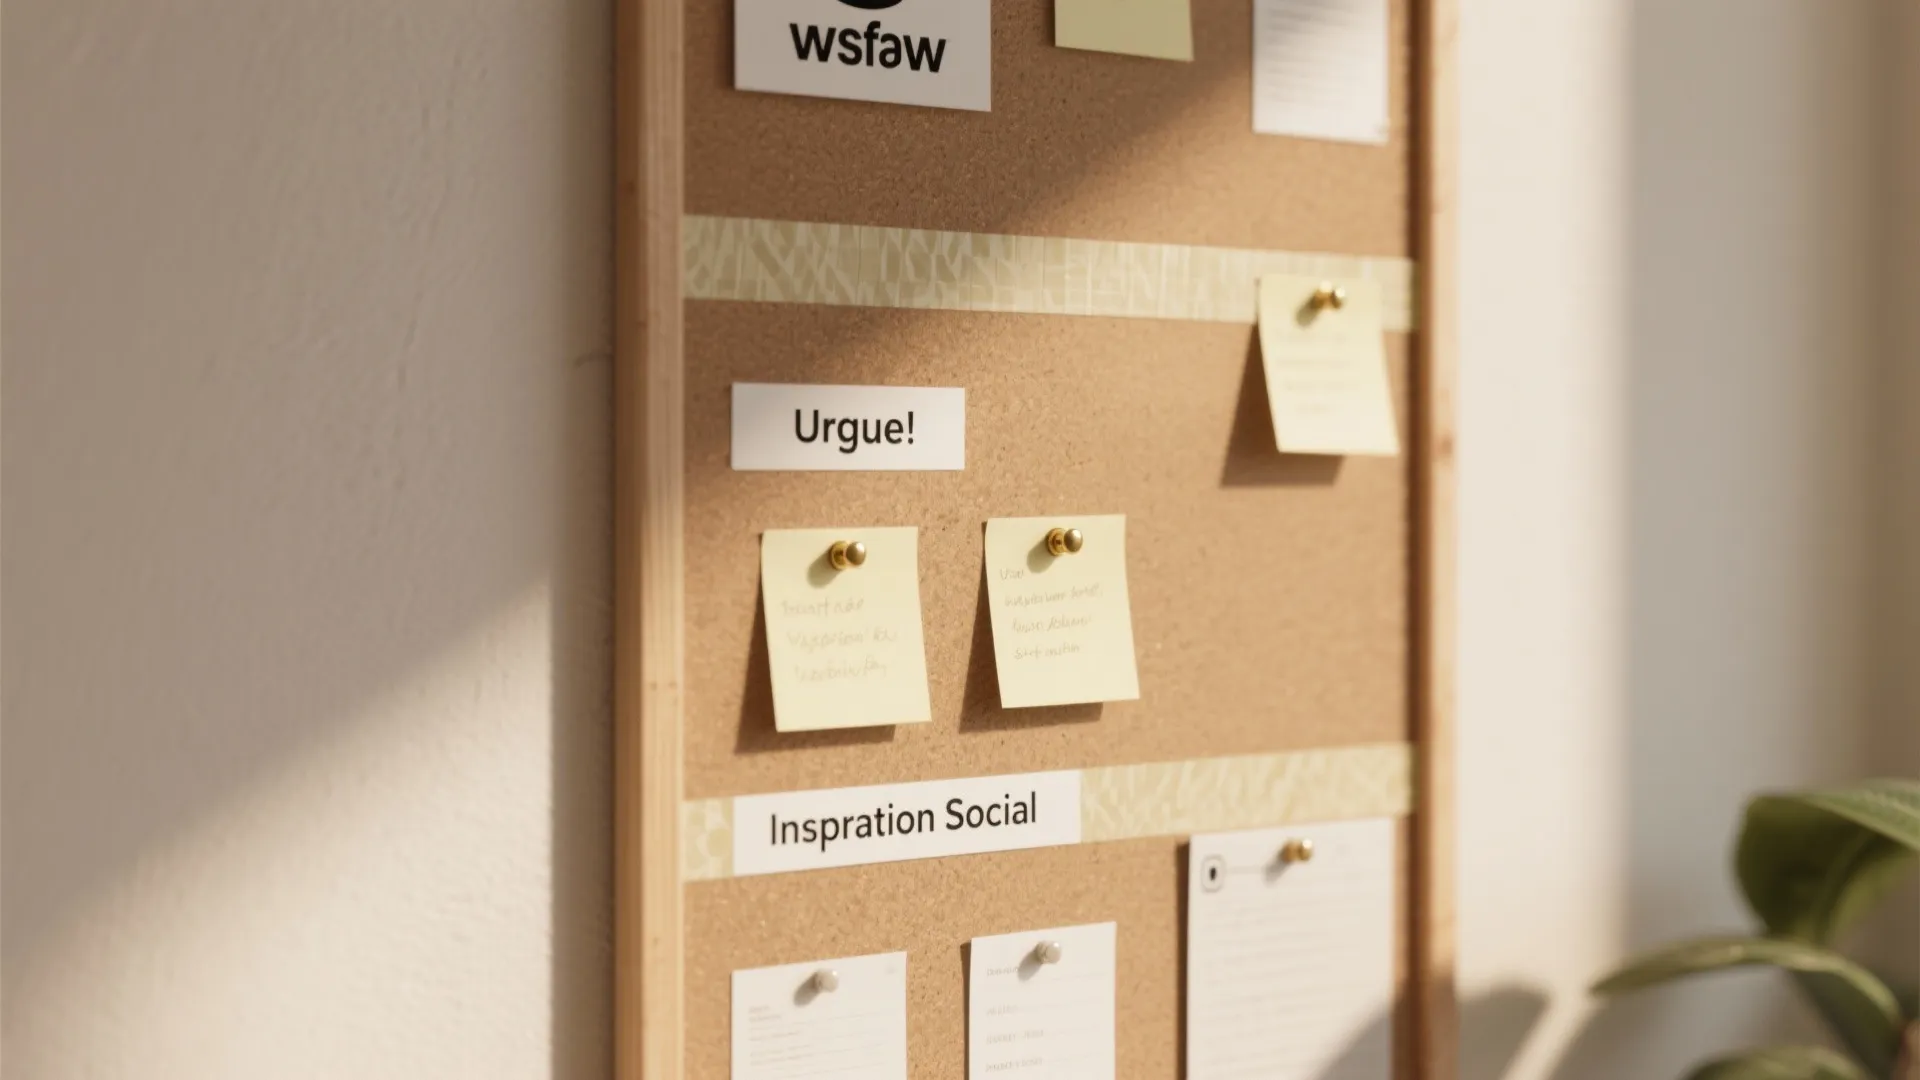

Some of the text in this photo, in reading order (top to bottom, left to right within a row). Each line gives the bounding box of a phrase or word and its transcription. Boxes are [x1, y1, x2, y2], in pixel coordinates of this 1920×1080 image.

[789, 20, 947, 73] wsfaw
[795, 408, 914, 454] Urgue!
[771, 791, 1036, 852] Inspration Social
